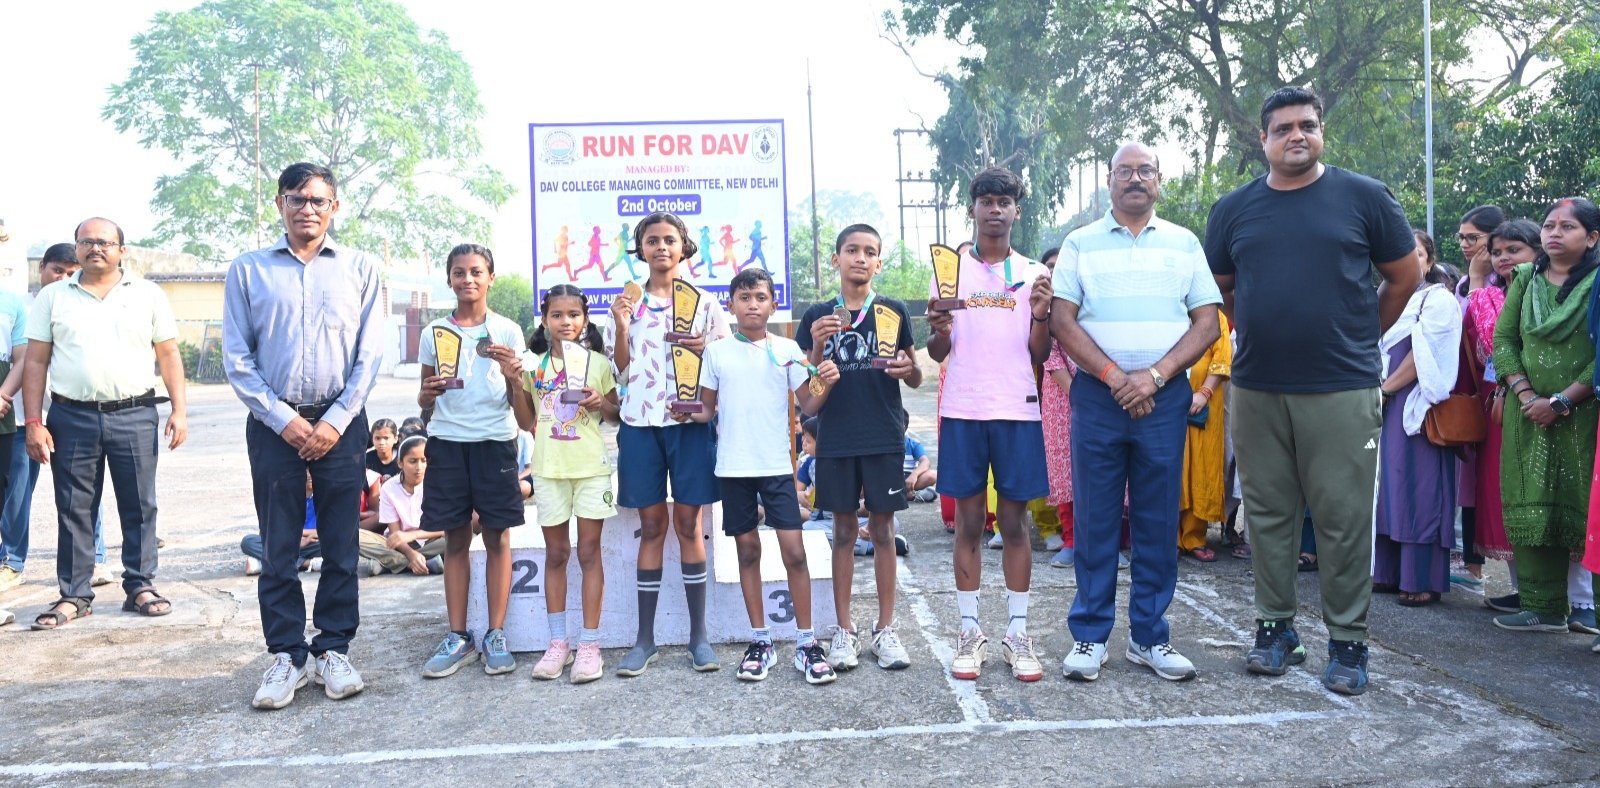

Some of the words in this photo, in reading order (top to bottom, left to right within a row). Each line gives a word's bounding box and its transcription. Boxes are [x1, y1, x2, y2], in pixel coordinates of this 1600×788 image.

[582, 135, 635, 157] RUN
[643, 134, 693, 156] FOR
[701, 133, 749, 156] DAV
[625, 165, 673, 174] MANAGED
[674, 164, 690, 173] BY:
[540, 181, 559, 193] DAV
[562, 180, 606, 192] COLLEGE
[609, 179, 661, 191] MANAGING
[664, 178, 724, 191] COMMITTEE,
[726, 177, 748, 189] NEW
[750, 177, 778, 189] DELHI
[621, 198, 644, 213] 2nd
[647, 197, 698, 212] October
[511, 559, 540, 593] 2
[768, 589, 795, 623] 3
